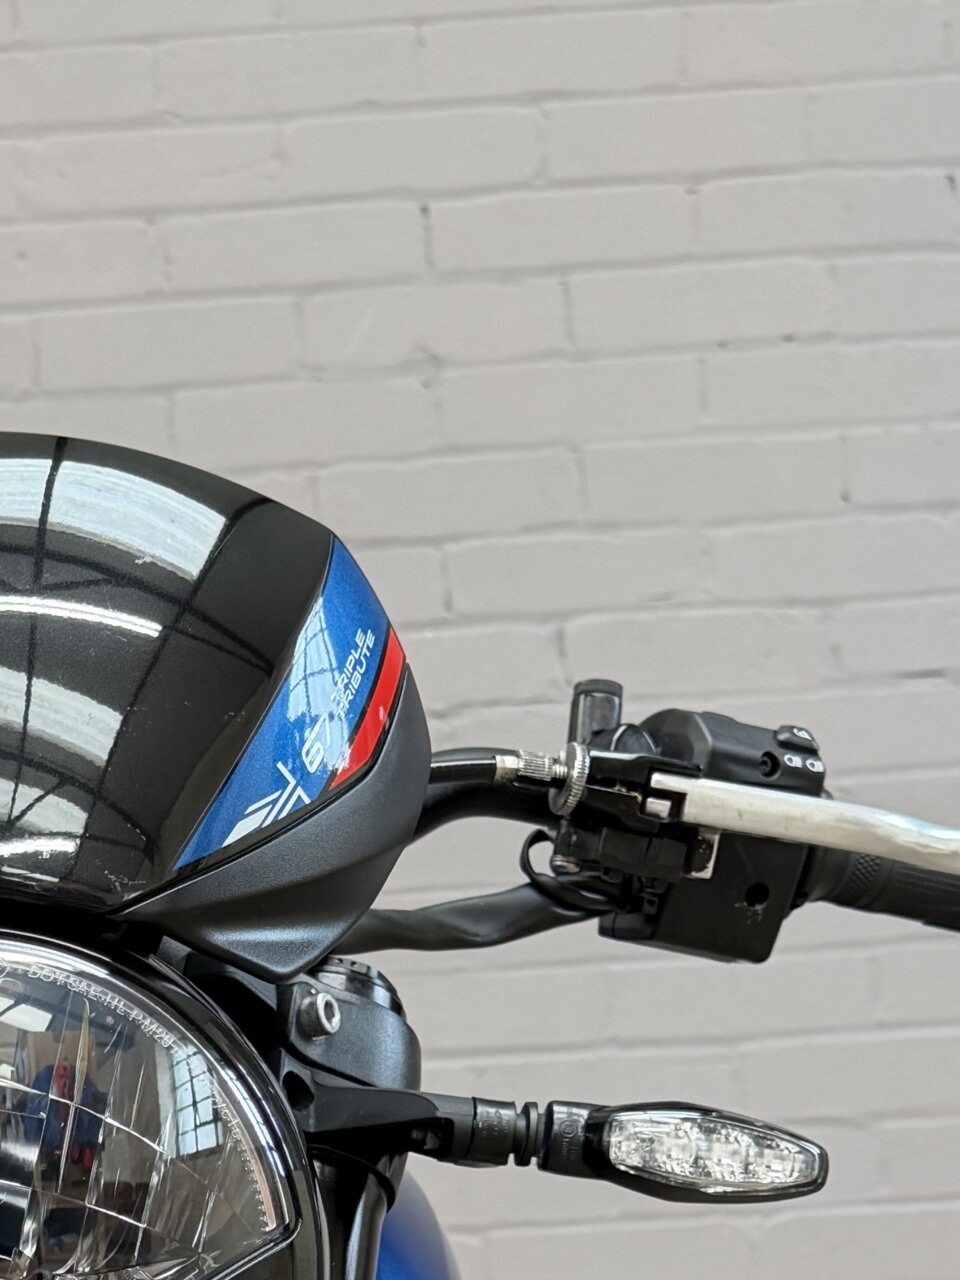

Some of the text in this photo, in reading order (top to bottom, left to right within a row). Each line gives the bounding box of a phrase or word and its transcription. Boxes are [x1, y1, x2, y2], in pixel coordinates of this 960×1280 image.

[330, 627, 367, 703] TRIPLE
[336, 628, 376, 719] TRIBUTE
[301, 711, 331, 774] 67
